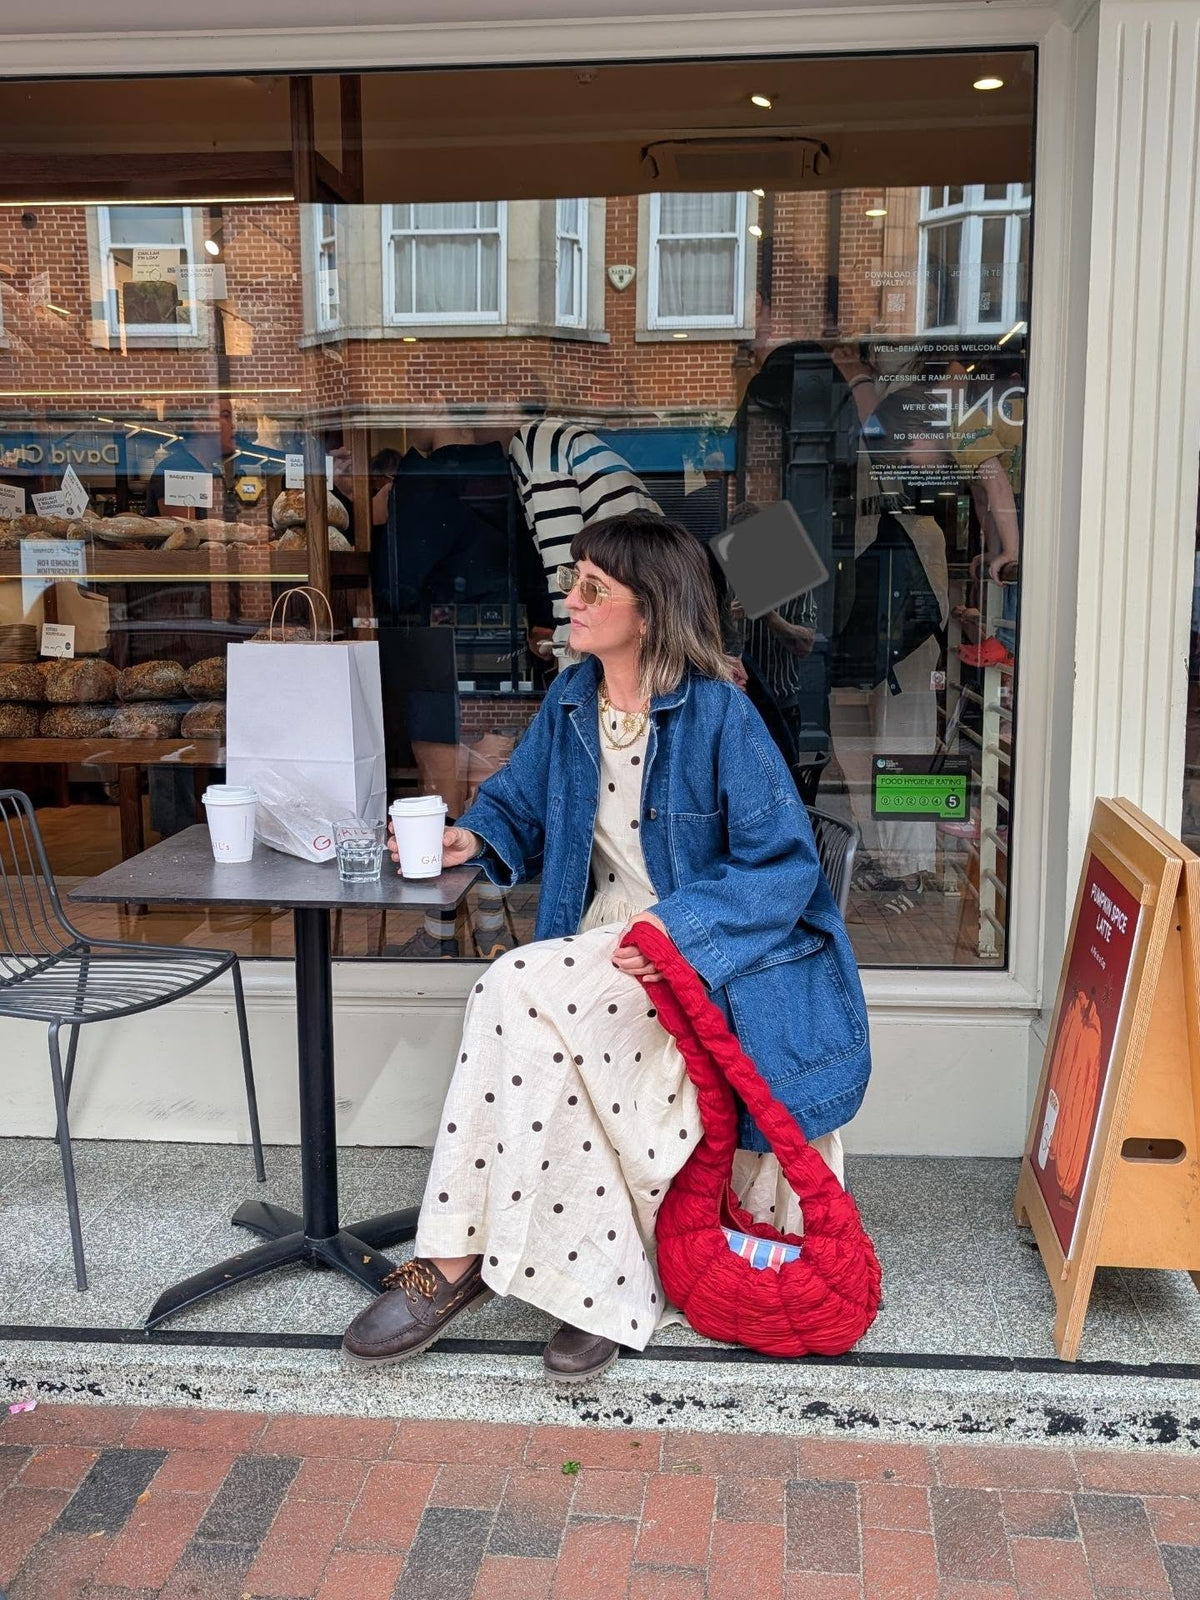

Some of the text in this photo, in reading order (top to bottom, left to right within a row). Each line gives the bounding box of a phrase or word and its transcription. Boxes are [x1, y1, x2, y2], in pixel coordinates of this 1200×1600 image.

[873, 344, 1001, 353] WELL-BEHAVED DOGS WELCOME
[878, 374, 926, 382] ACCESSIBLE
[953, 373, 995, 381] AVAILABLE
[902, 403, 926, 411] WE'RE
[946, 432, 976, 440] PLEASE
[936, 778, 962, 786] RATING
[948, 795, 957, 807] 5
[1110, 904, 1128, 935] SPICE
[1096, 914, 1112, 943] LATTE
